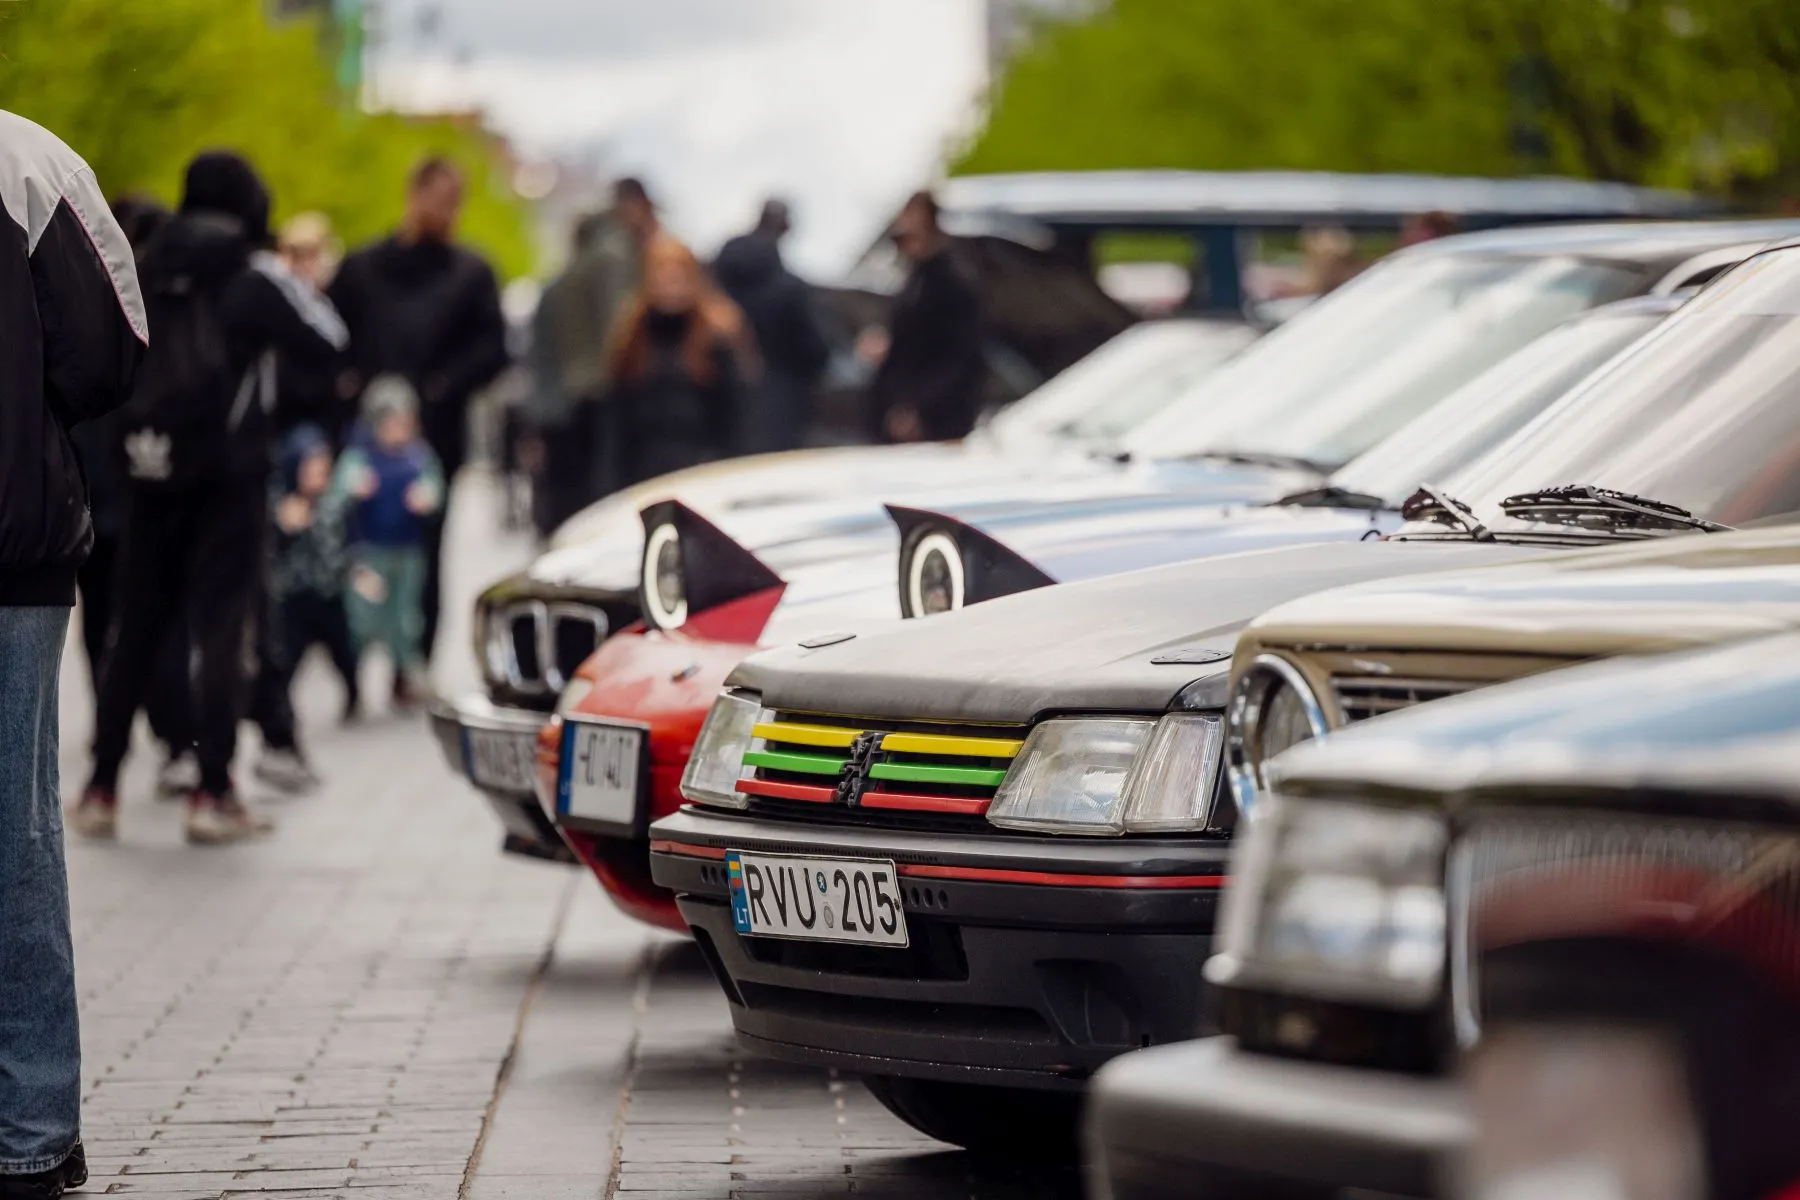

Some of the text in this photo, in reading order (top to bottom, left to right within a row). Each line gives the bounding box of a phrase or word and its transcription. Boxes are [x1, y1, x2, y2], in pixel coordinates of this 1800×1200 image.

[736, 907, 749, 925] LT
[745, 863, 898, 936] RVU 205
